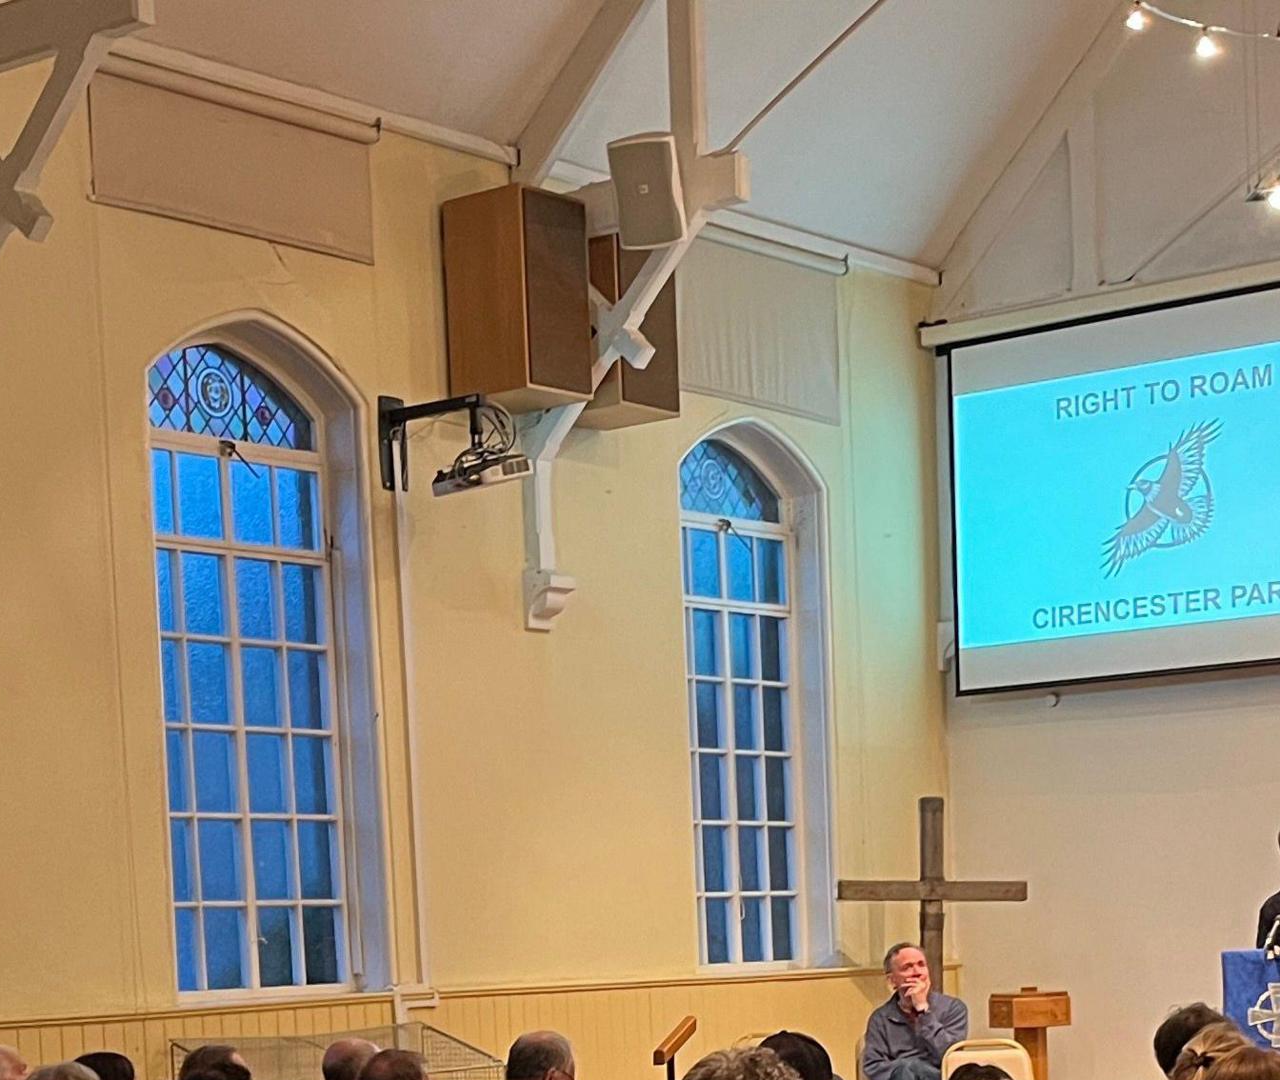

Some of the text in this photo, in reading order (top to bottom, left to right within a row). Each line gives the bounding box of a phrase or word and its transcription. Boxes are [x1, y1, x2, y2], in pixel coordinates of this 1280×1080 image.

[1055, 363, 1273, 420] RIGHT TO ROAM
[1032, 588, 1222, 630] CIRENCESTER
